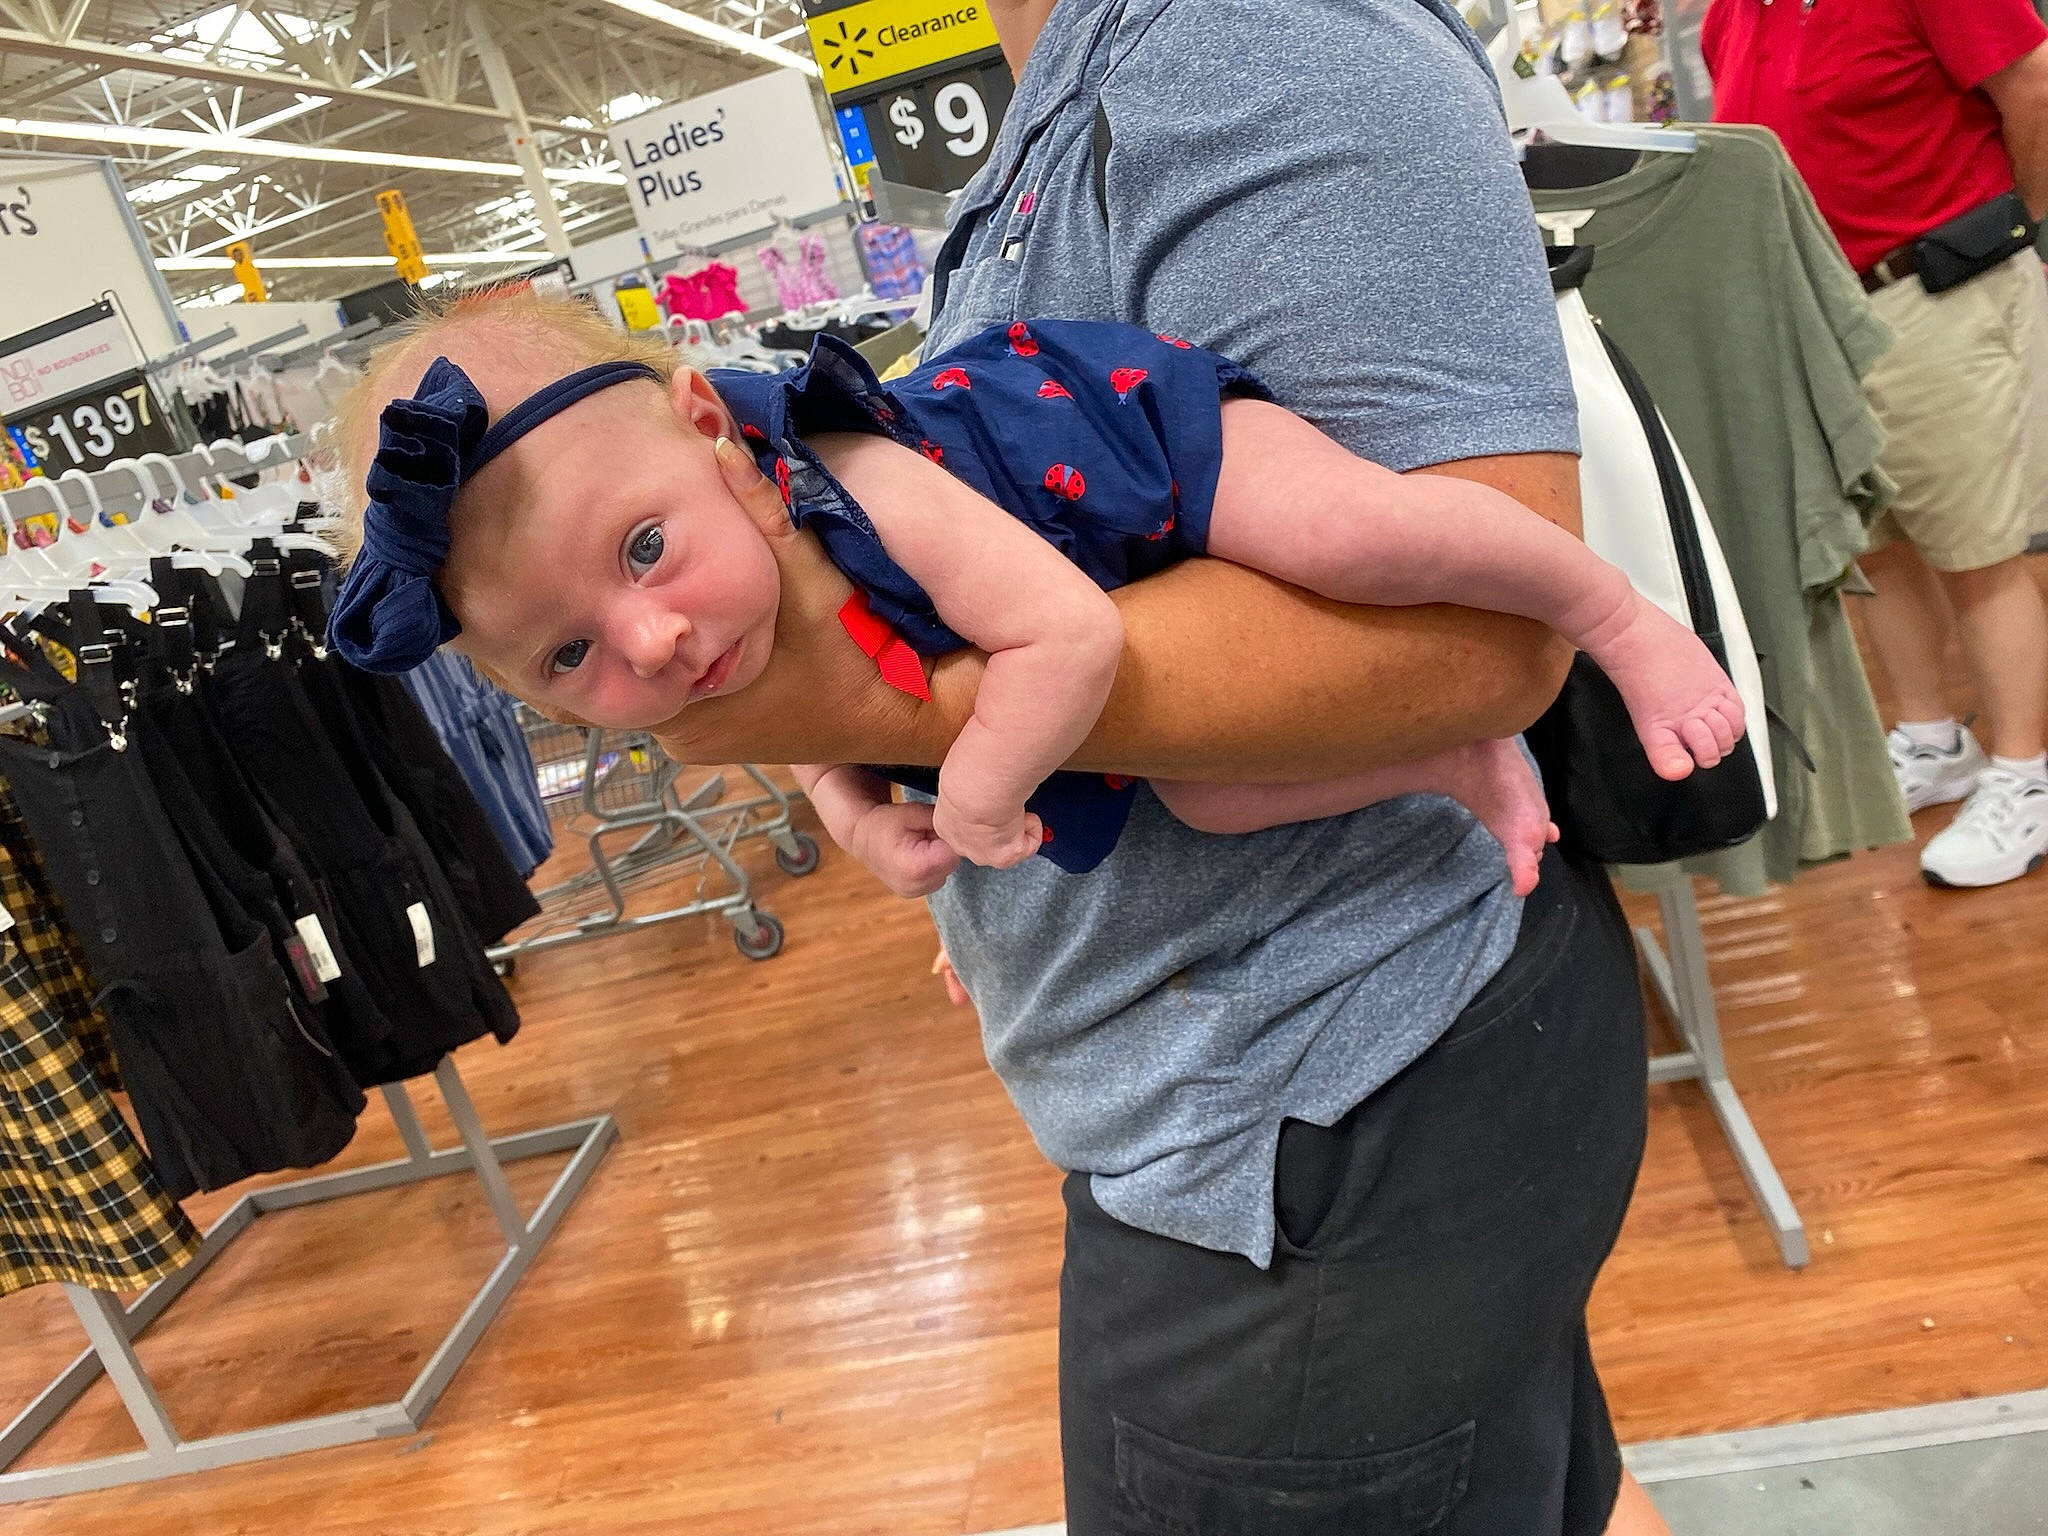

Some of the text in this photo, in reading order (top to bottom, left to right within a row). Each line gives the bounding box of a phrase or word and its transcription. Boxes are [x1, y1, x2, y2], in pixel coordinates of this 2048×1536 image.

[877, 6, 978, 47] Clearance
[624, 107, 726, 169] Ladies'
[637, 170, 703, 207] Plus
